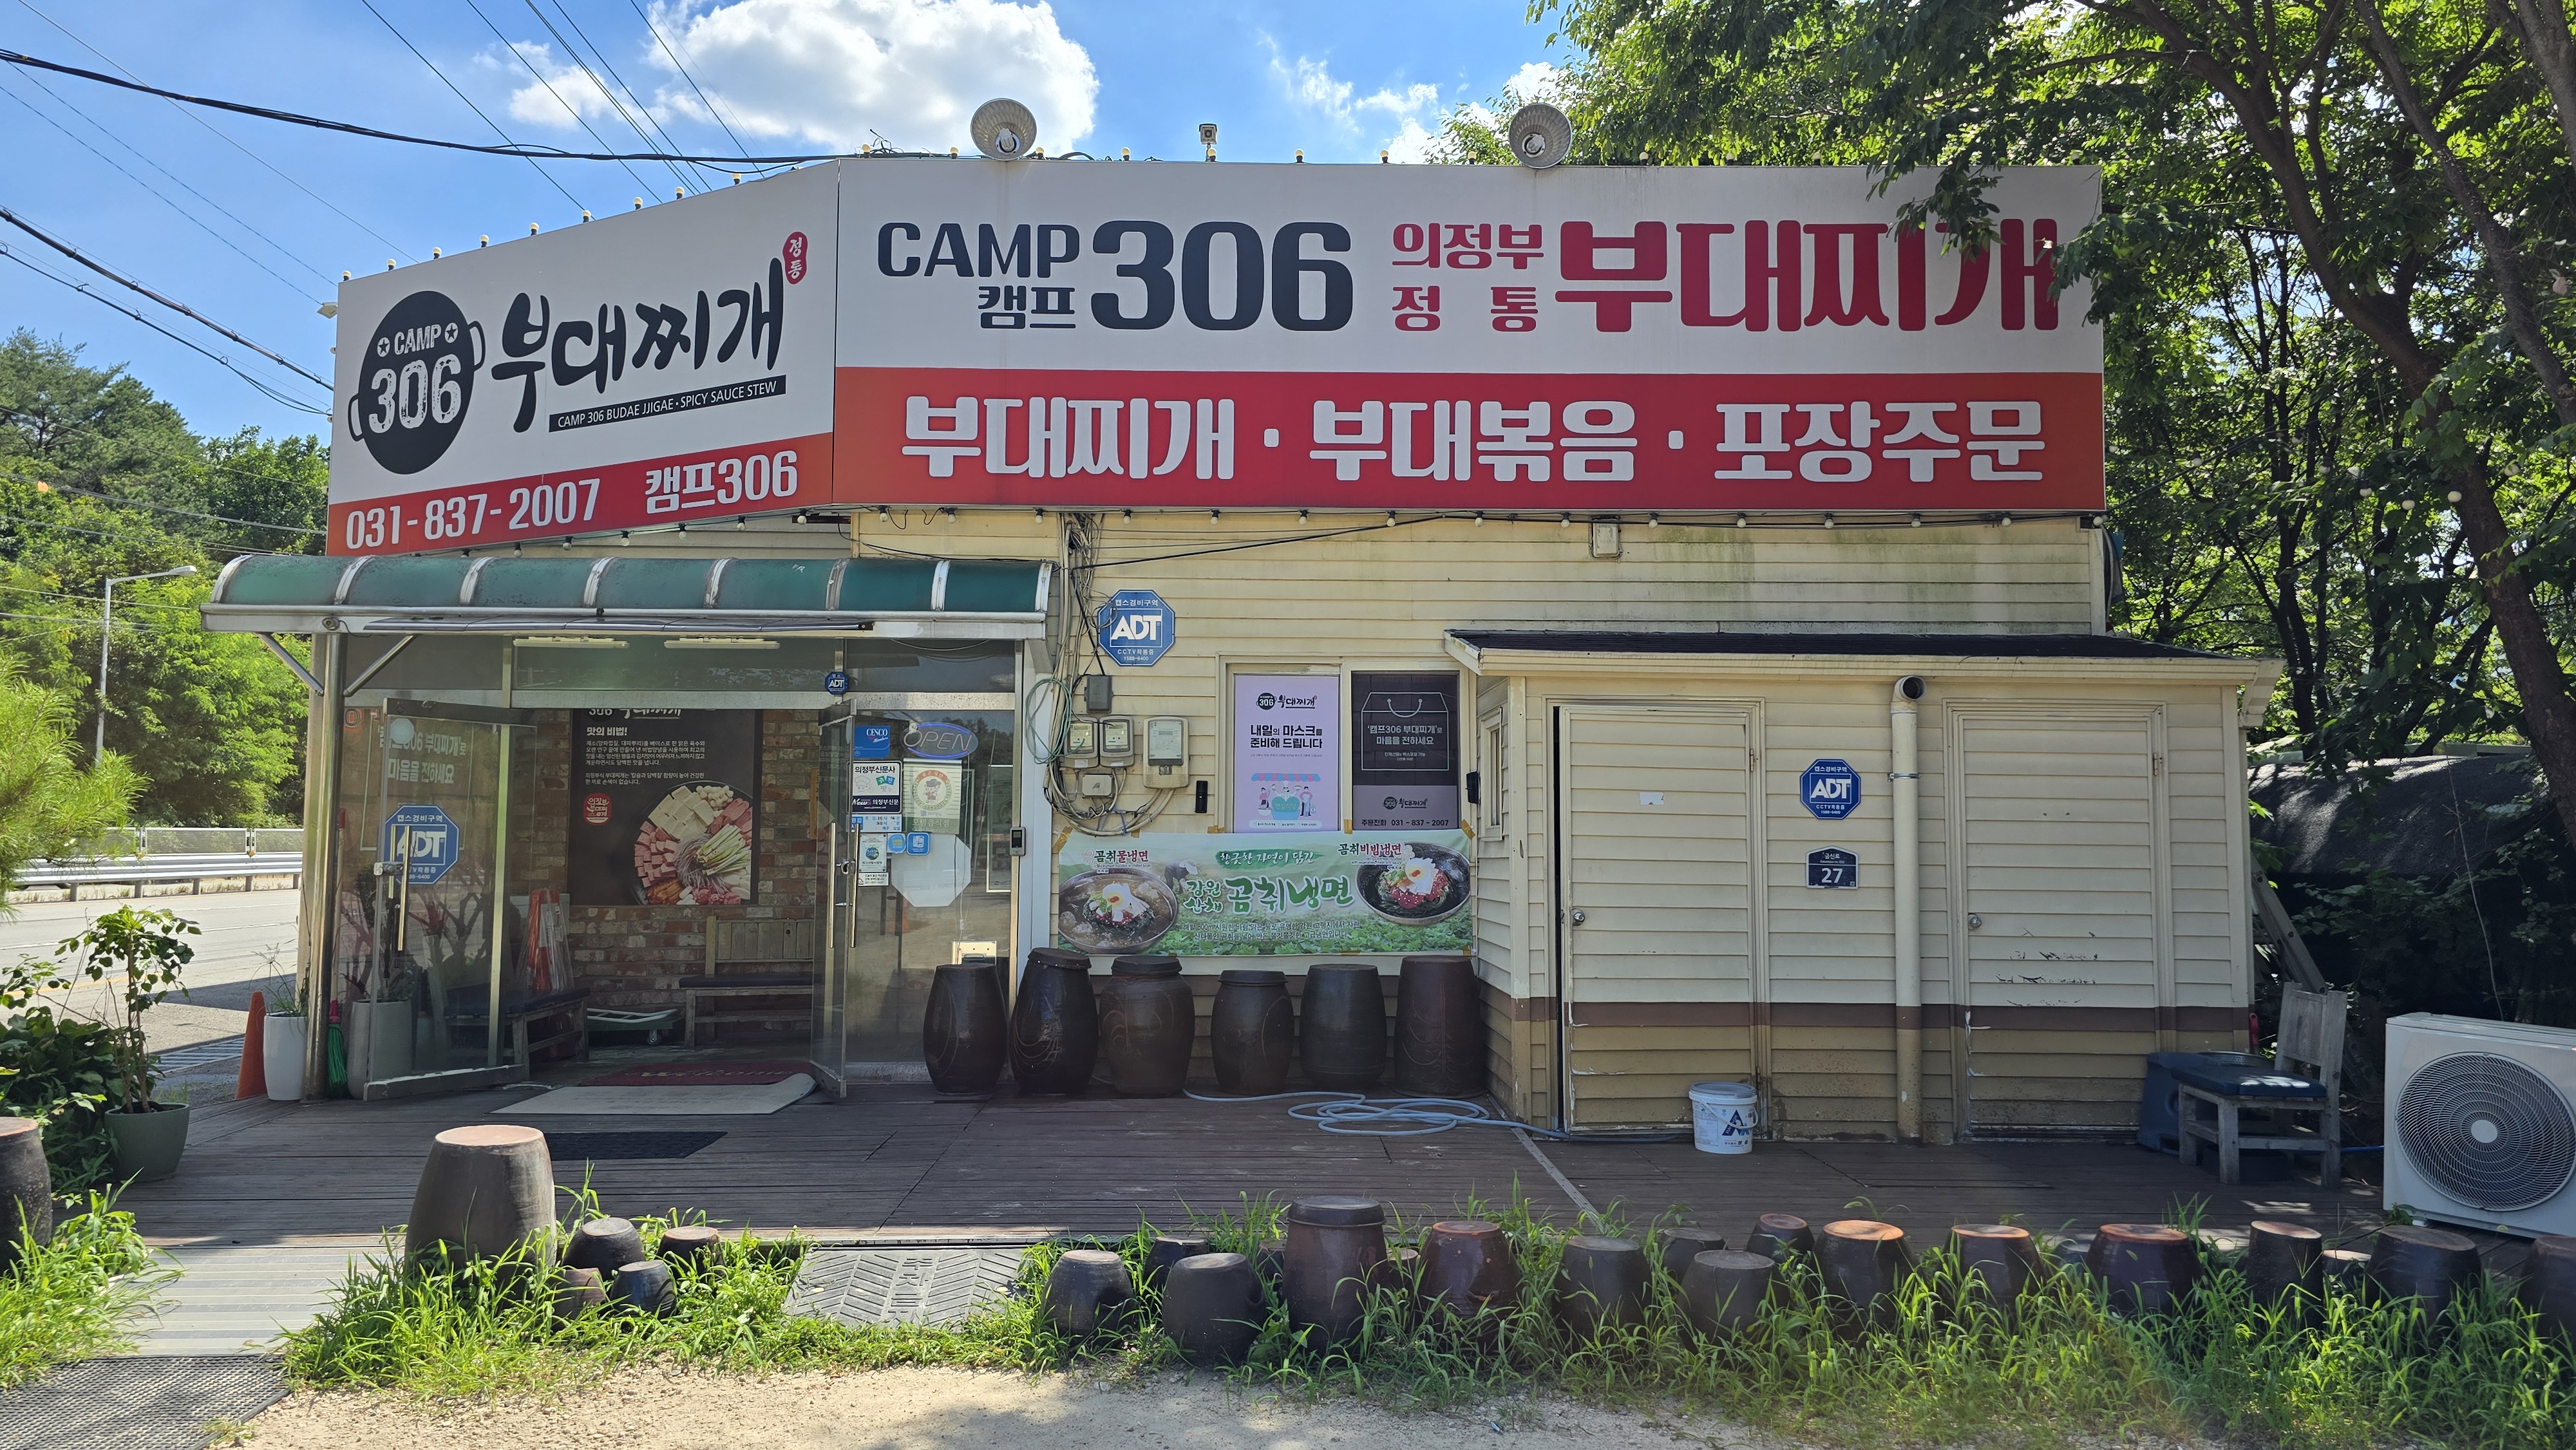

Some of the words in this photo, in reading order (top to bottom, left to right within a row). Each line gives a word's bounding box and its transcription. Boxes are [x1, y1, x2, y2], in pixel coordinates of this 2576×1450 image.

[877, 222, 1080, 278] CAMP
[1392, 223, 1544, 269] 의정부
[787, 236, 804, 279] 정통
[1091, 220, 1353, 331] 306
[1555, 219, 2058, 333] 부대찌개
[978, 285, 1076, 330] 캠프
[394, 324, 441, 355] CAMP
[491, 258, 784, 433] 부대찌개
[368, 353, 461, 434] 306
[558, 413, 585, 428] CAMP
[587, 410, 604, 424] 306
[607, 404, 639, 420] BUDAE
[710, 386, 744, 403] SAUCE
[747, 381, 777, 397] STEW
[902, 395, 1235, 480] 부대찌개
[1309, 399, 1638, 482] 부대볶음
[1714, 400, 2045, 483] 포장주문
[346, 477, 600, 549] 031-837-2007
[645, 450, 799, 514] 캠프306
[1111, 615, 1162, 640] ADT
[828, 679, 845, 688] ADT
[1277, 695, 1314, 708] 부대찌개
[587, 727, 605, 736] 맛의
[607, 727, 628, 736] 비법!
[904, 730, 972, 751] OPEN
[1251, 725, 1280, 736] 내일의
[1283, 725, 1322, 736] 마스크를
[1376, 736, 1400, 744] 마음을
[1401, 736, 1434, 744] 전하세요
[1250, 738, 1280, 748] 준비해
[1282, 738, 1322, 749] 드립니다
[387, 758, 420, 782] 마음을
[421, 762, 455, 784] 전하세요
[1810, 778, 1852, 799] ADT
[1399, 798, 1426, 808] 부대찌개
[912, 818, 949, 827] 모범음식점
[1094, 850, 1149, 863] 곰취물냉면
[1220, 852, 1253, 865] 향긋한
[1256, 852, 1289, 864] 자연이
[1293, 851, 1314, 865] 담긴
[1338, 843, 1402, 855] 곰취비빔냉면
[1821, 867, 1843, 883] 27
[1186, 880, 1221, 897] 강원
[1225, 876, 1354, 913] 곰취냉면
[1184, 896, 1222, 913] 산채
